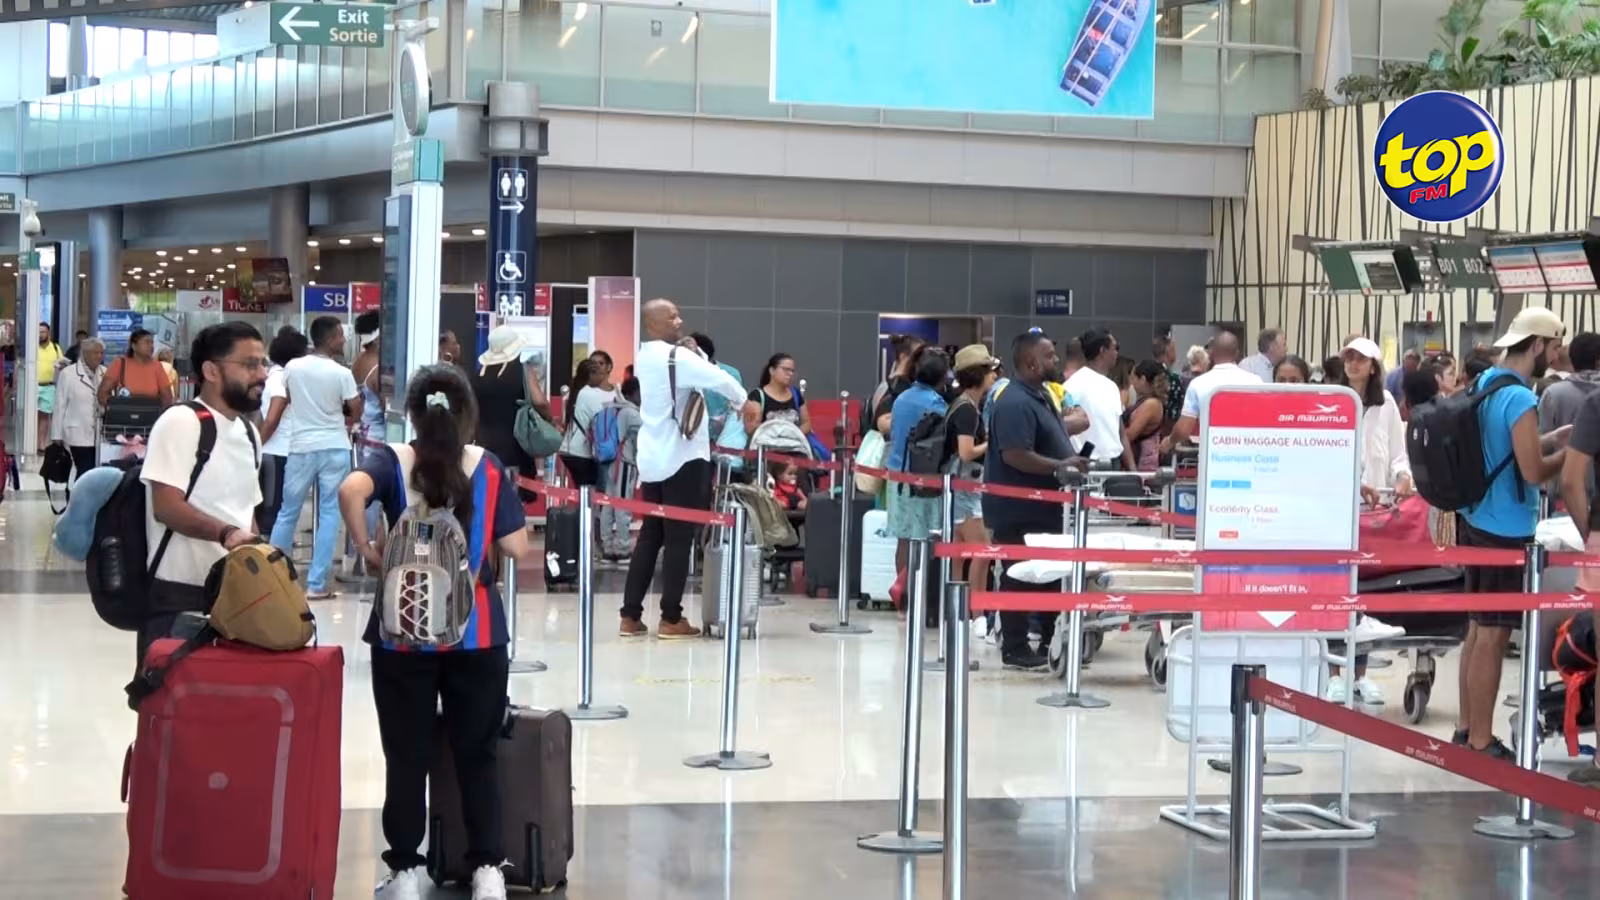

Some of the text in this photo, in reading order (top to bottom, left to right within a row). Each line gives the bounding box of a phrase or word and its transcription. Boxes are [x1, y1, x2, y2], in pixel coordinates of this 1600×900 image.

[338, 9, 369, 24] Exit
[329, 27, 378, 43] Sortie
[1438, 258, 1486, 274] B01 B02
[323, 292, 346, 307] SB
[1212, 436, 1350, 447] CABIN BAGGAGE ALLOWANCE
[1211, 453, 1279, 464] Business Class
[1209, 504, 1279, 516] Economy Class
